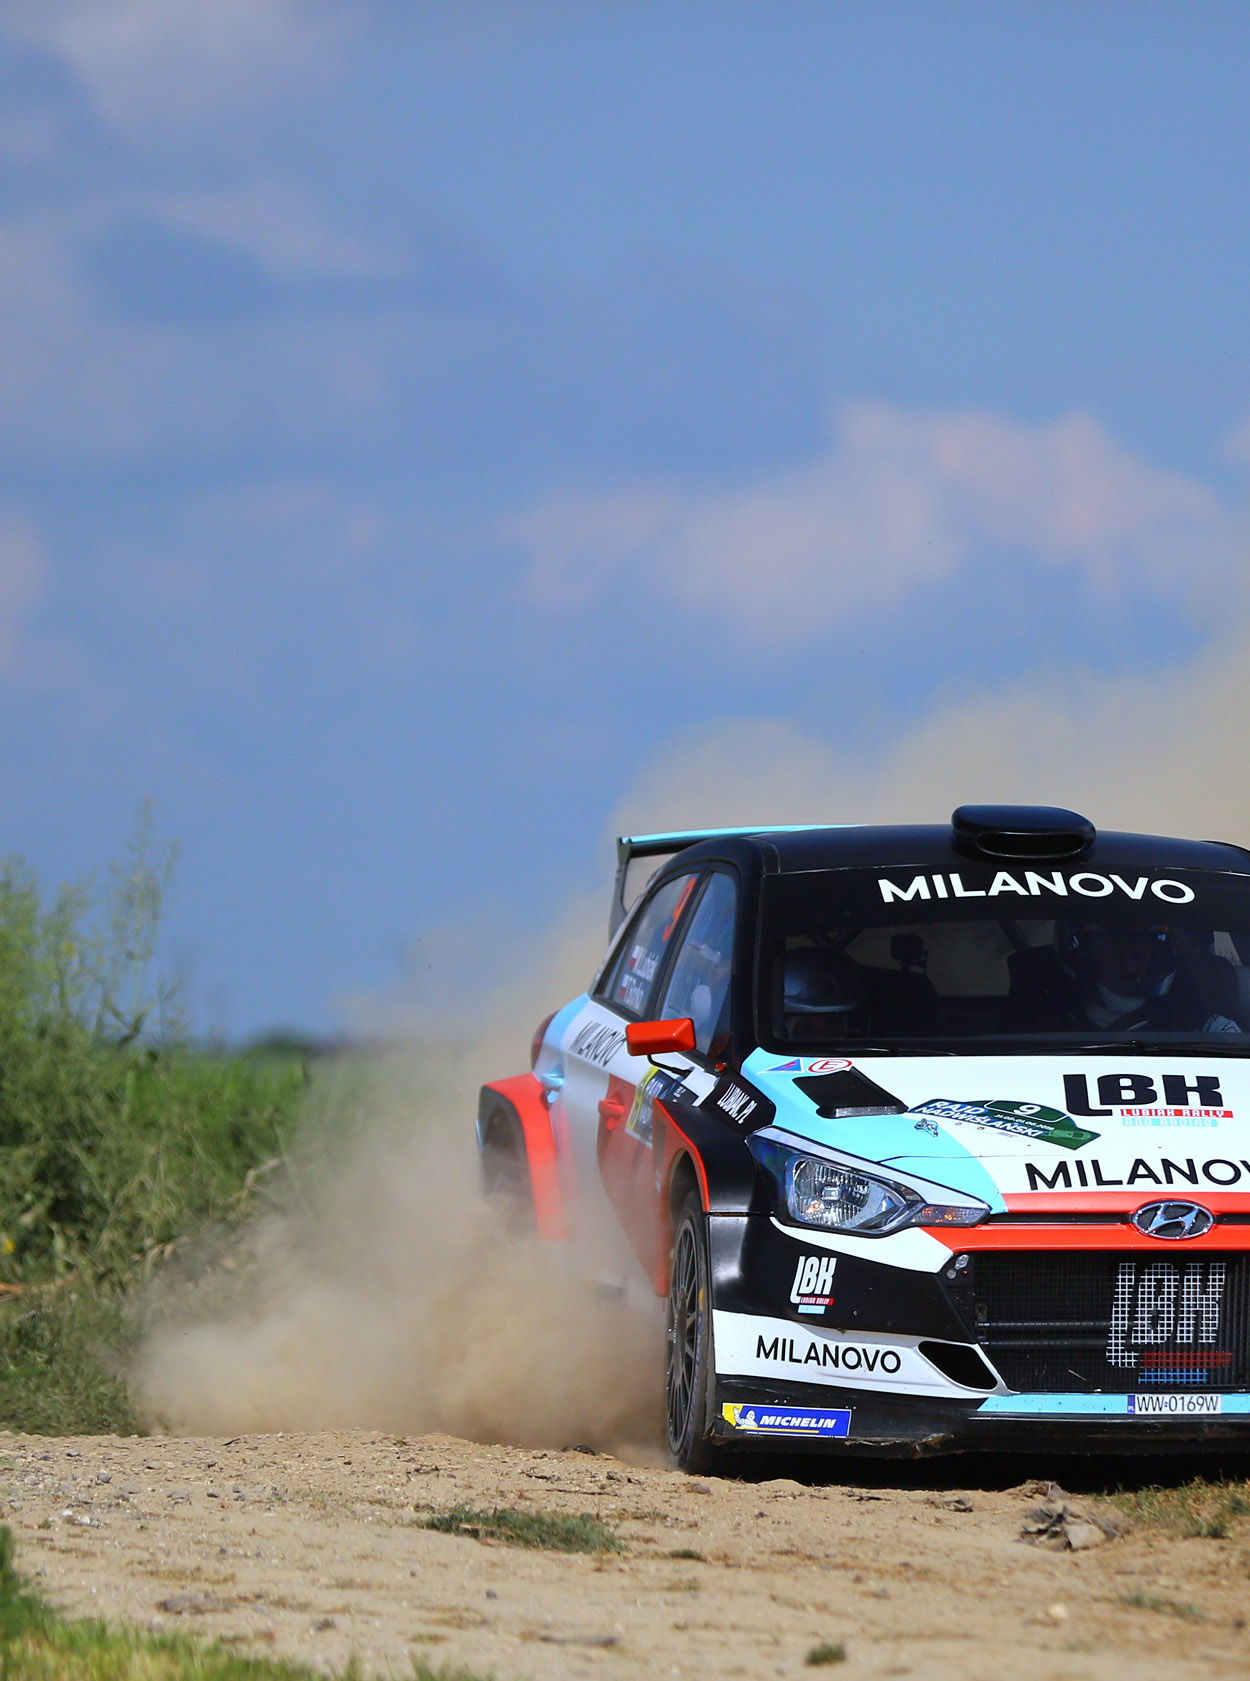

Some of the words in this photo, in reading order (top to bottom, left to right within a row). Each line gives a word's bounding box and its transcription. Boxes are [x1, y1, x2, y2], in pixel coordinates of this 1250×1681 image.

[878, 872, 1196, 904] MILANOVO
[568, 1020, 627, 1067] MILANOVO
[928, 1101, 985, 1115] RAID
[1013, 1104, 1042, 1116] 9
[1063, 1074, 1224, 1117] LBK
[1123, 1109, 1175, 1117] LUBIAK
[1182, 1109, 1225, 1118] RALLY
[789, 1256, 837, 1304] LBK
[756, 1335, 902, 1374] MILANOVO
[760, 1415, 837, 1429] MICHELIN
